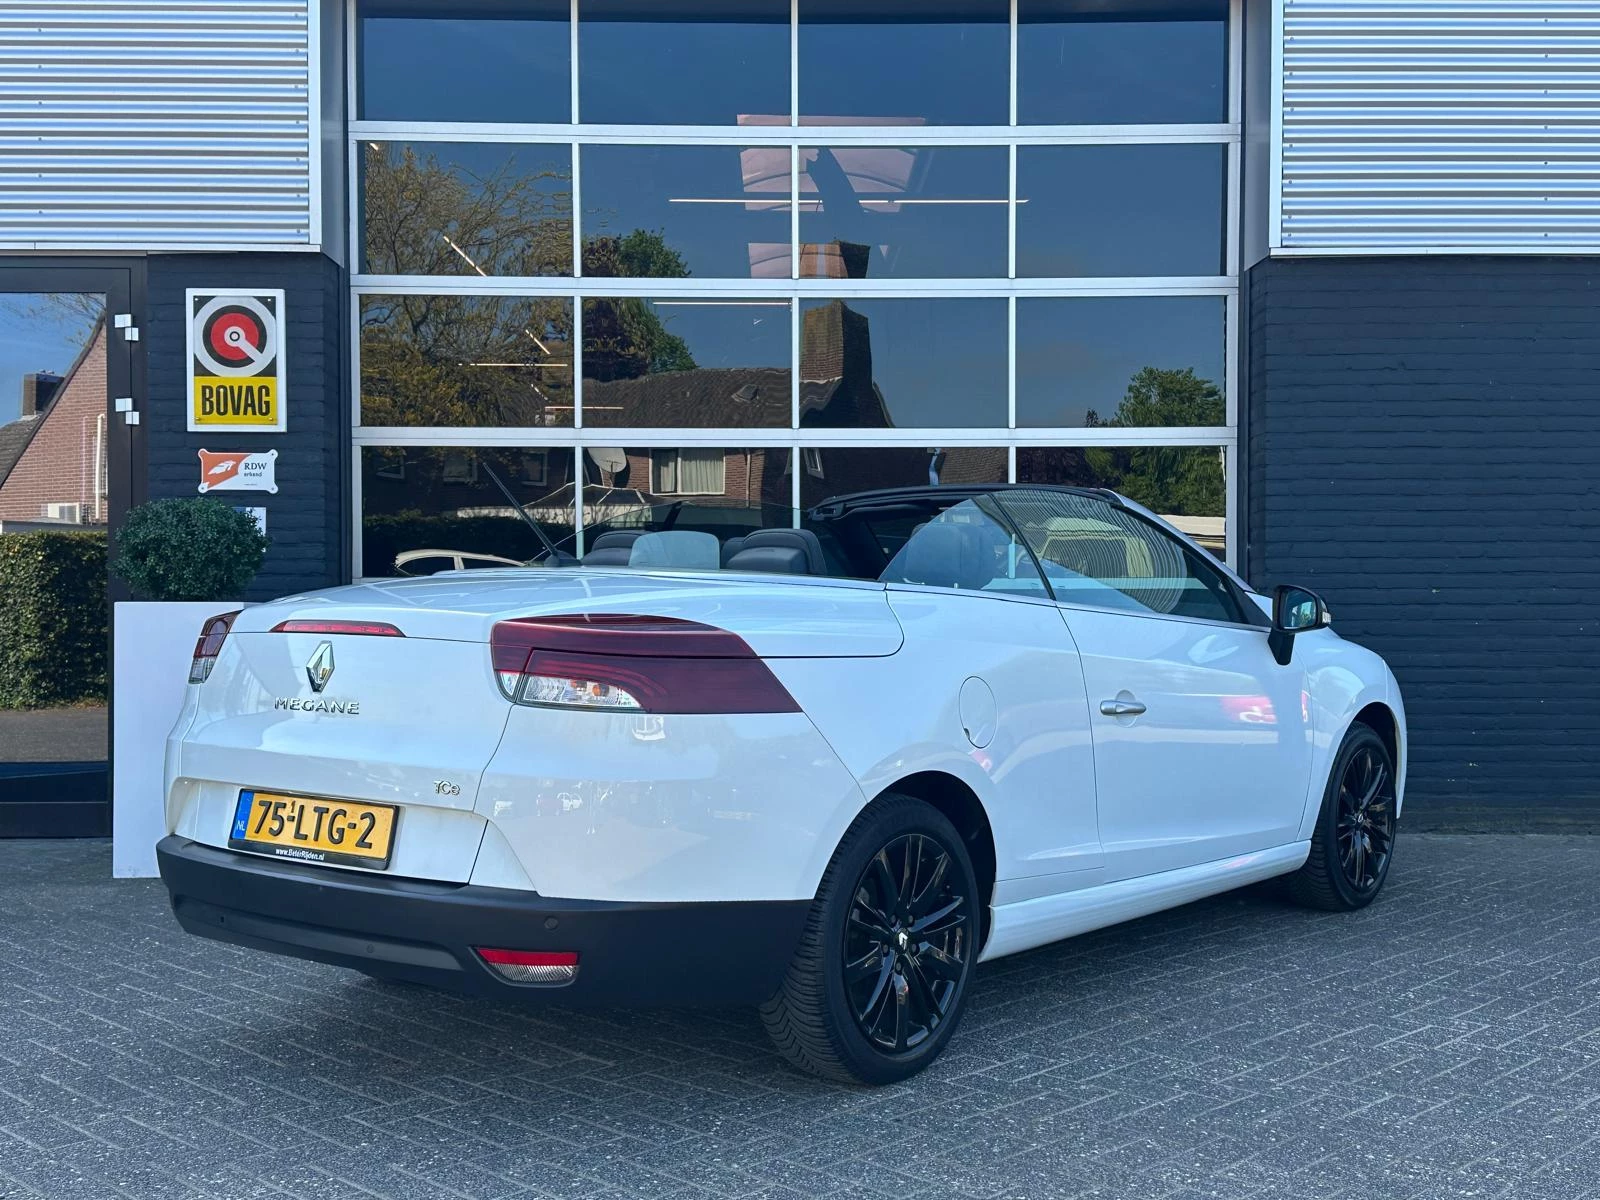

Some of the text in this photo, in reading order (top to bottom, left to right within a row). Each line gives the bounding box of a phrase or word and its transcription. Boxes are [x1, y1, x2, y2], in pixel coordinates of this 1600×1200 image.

[202, 385, 270, 416] BOVAG
[244, 462, 267, 471] RDW
[274, 697, 359, 715] MEGANE
[433, 780, 460, 796] TCe
[236, 820, 245, 831] NL
[254, 800, 376, 849] 75-LTG-2
